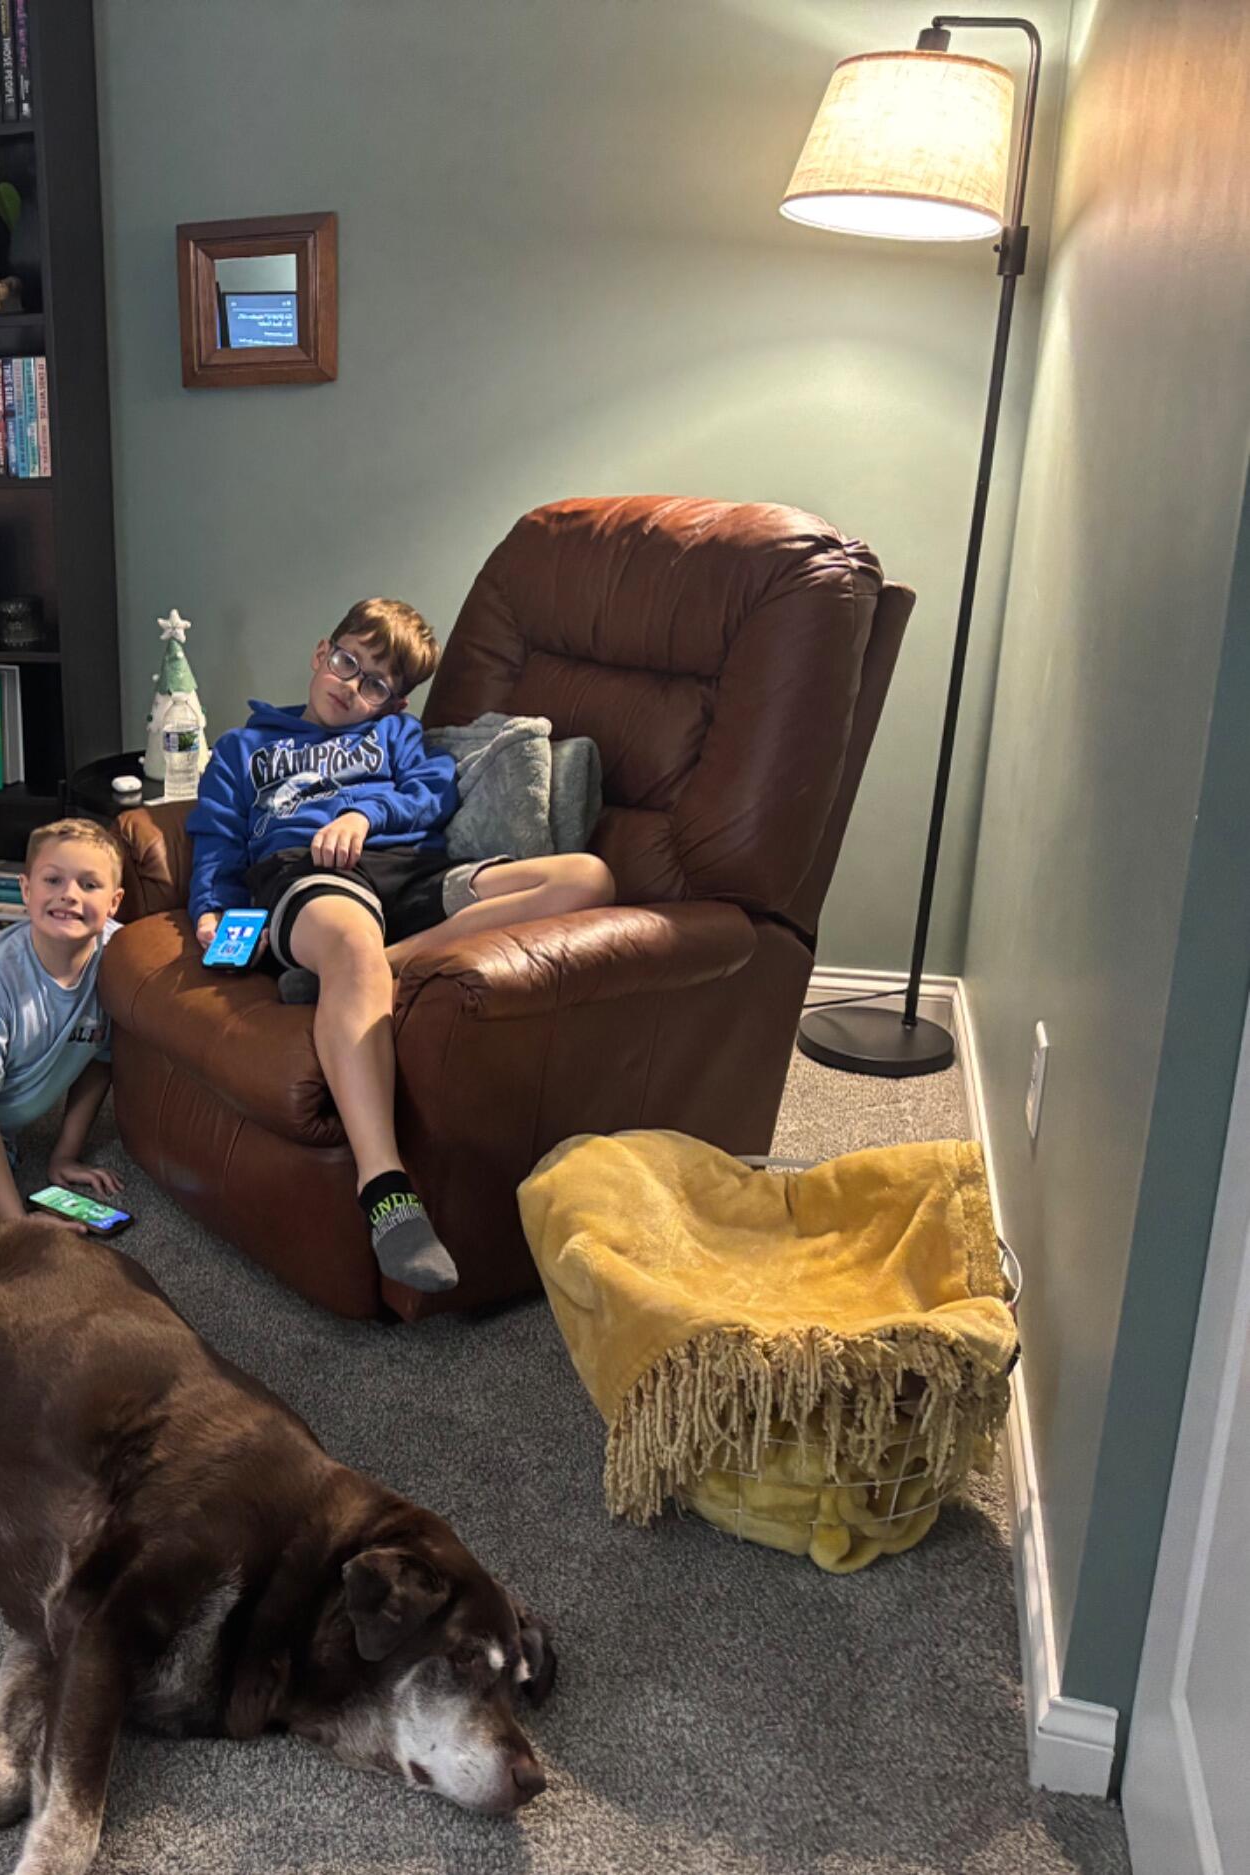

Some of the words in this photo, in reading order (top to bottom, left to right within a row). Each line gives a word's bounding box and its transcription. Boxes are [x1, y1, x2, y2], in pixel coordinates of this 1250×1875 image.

[2, 37, 13, 67] THOSE
[4, 69, 15, 104] PEOPLE
[3, 364, 13, 383] THIS
[369, 1193, 422, 1225] UNDE
